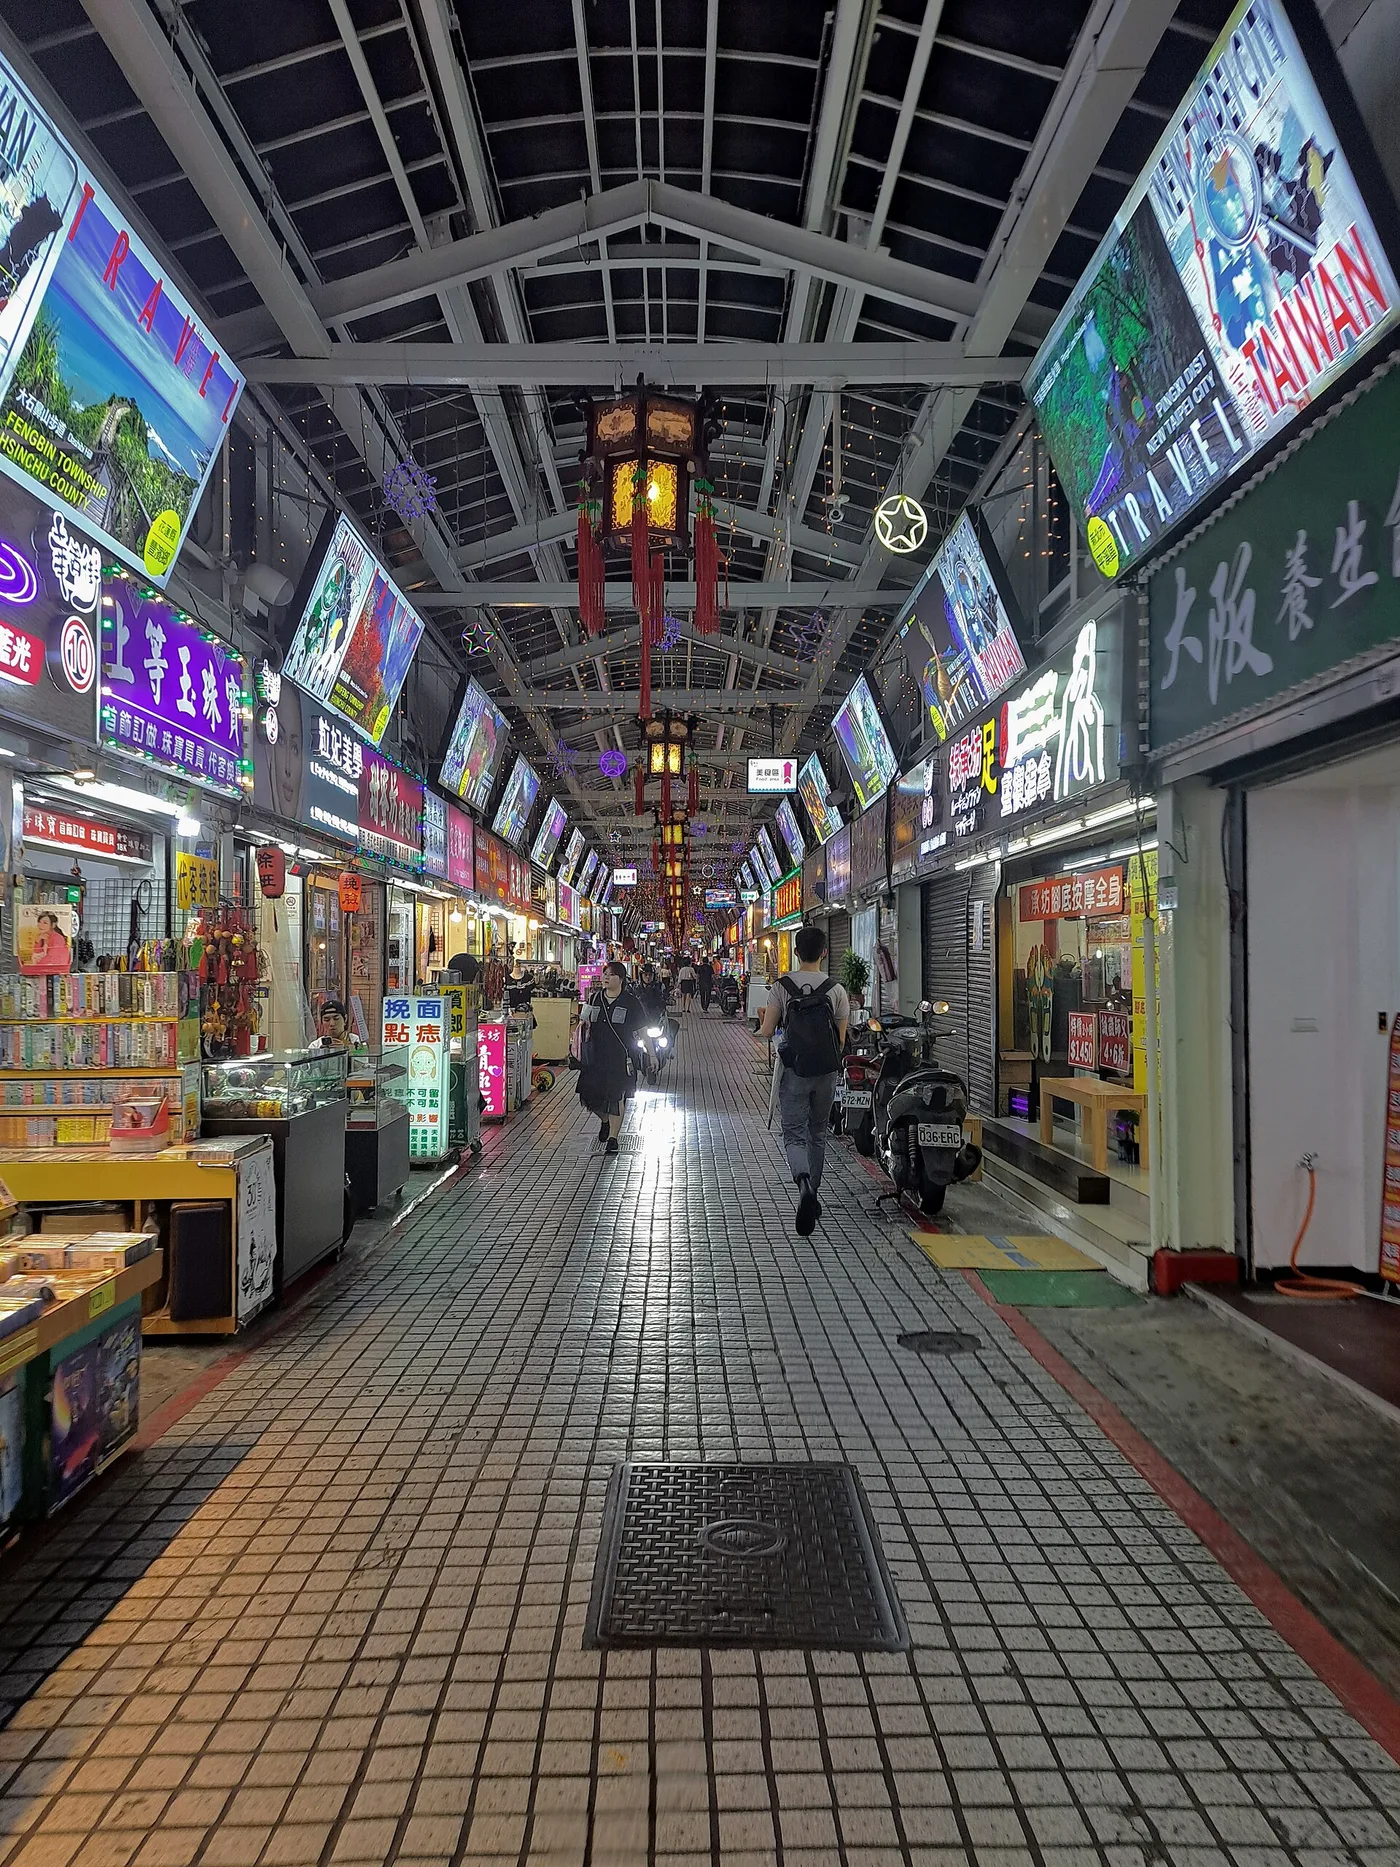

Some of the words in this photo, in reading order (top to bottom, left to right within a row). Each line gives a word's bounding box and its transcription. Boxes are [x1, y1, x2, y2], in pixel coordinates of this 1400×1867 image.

[66, 180, 239, 424] TRAVEL
[1240, 221, 1391, 417] TAIWAN
[1192, 369, 1216, 406] CITY
[0, 431, 50, 481] HSINCHU
[49, 472, 91, 512] COUNTY
[6, 410, 57, 461] FENGBIN
[57, 450, 107, 500] TOWNSHIP
[1107, 396, 1243, 557] TRAVEL
[384, 1000, 442, 1020] 挽面
[384, 1023, 442, 1043] 點痣
[1070, 1039, 1094, 1065] $1450
